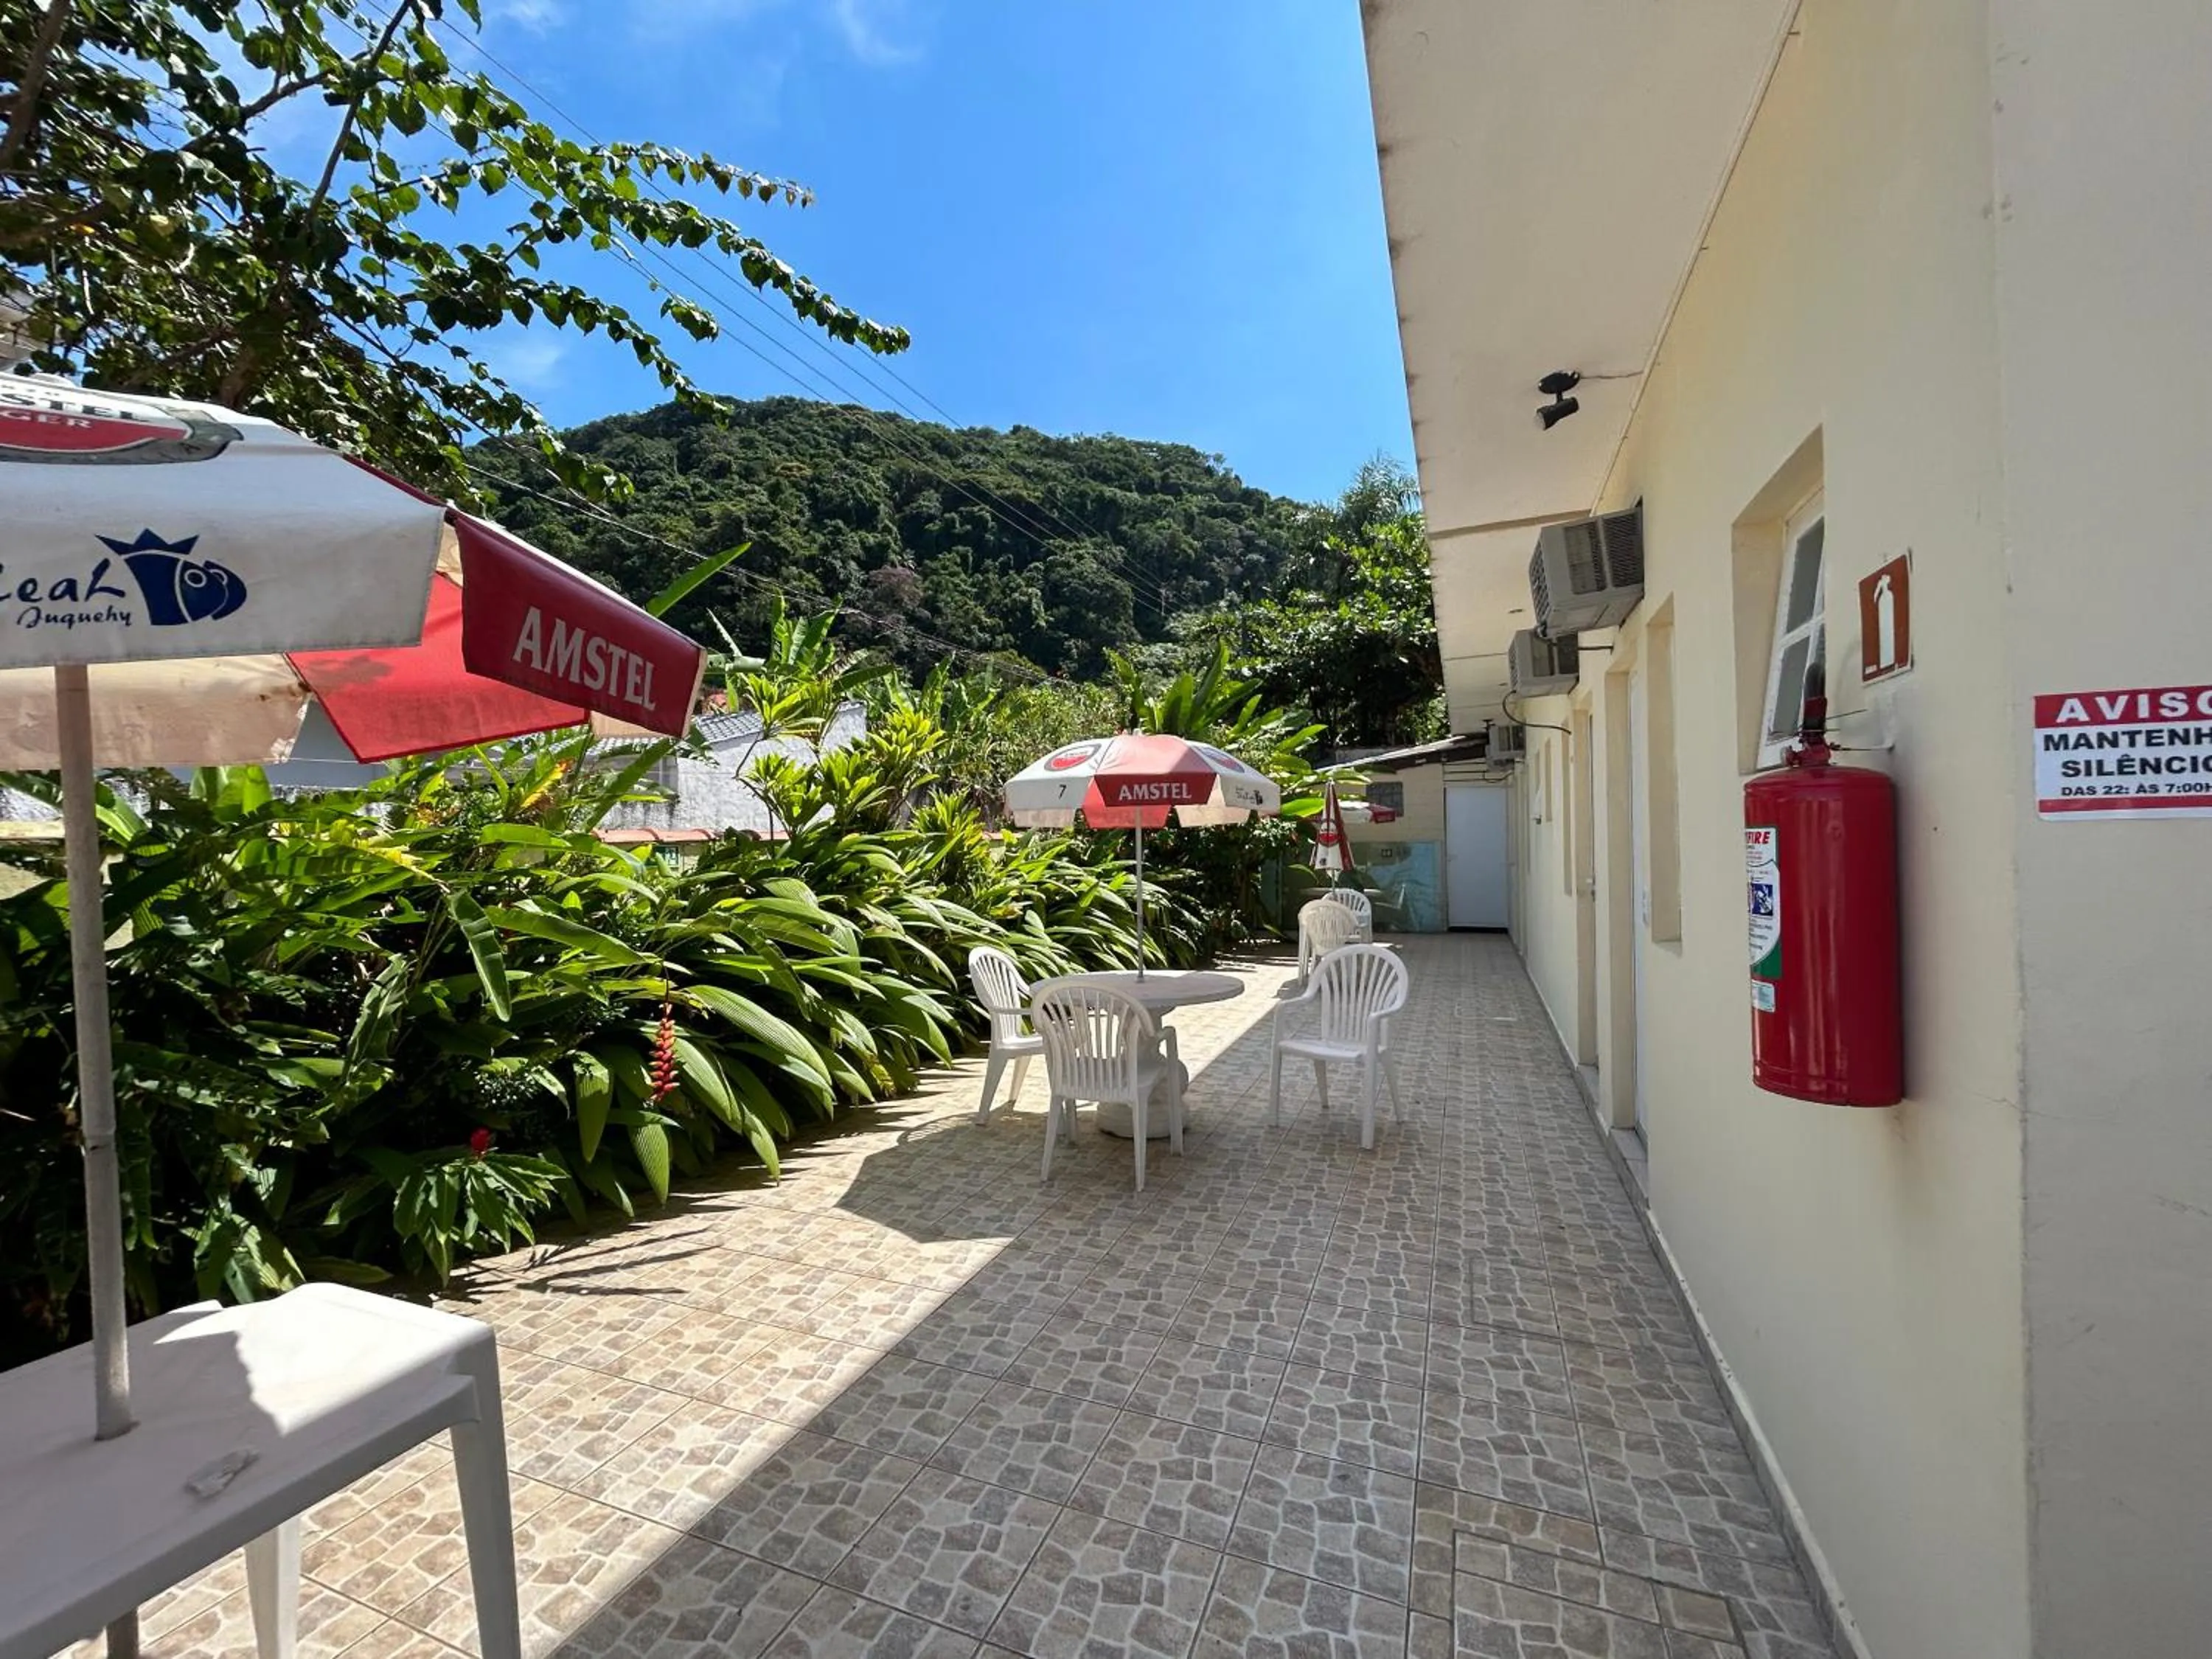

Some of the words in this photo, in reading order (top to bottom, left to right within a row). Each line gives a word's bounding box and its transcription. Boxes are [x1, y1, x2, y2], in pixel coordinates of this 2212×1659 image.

[17, 606, 132, 630] Juquehy
[512, 605, 655, 711] AMSTEL
[1058, 784, 1067, 800] 7
[1119, 782, 1192, 801] AMSTEL
[2062, 786, 2096, 796] DAS
[2102, 785, 2129, 795] 22:
